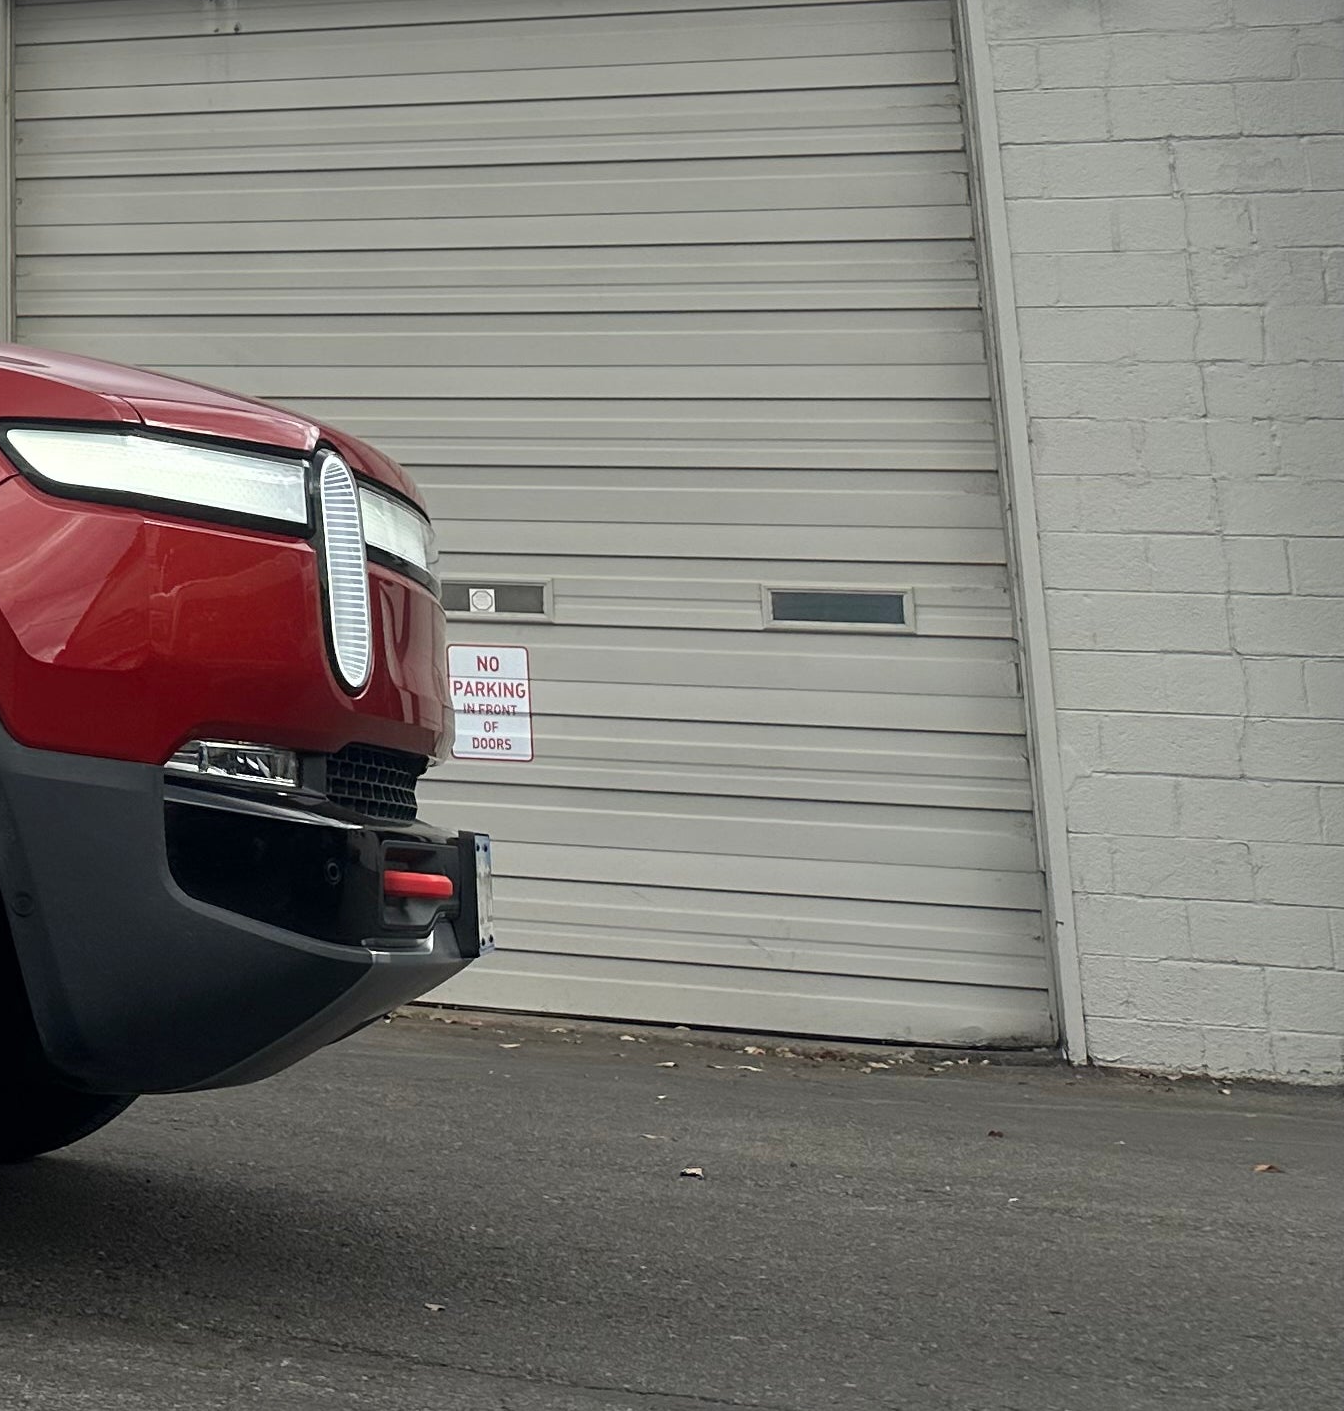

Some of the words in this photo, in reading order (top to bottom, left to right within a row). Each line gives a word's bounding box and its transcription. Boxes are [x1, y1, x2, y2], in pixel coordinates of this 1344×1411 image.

[476, 655, 500, 672] NO
[453, 680, 527, 699] PARKING
[463, 702, 476, 715] IN
[478, 703, 518, 716] FRONT
[483, 720, 500, 733] OF
[472, 736, 513, 751] DOORS
